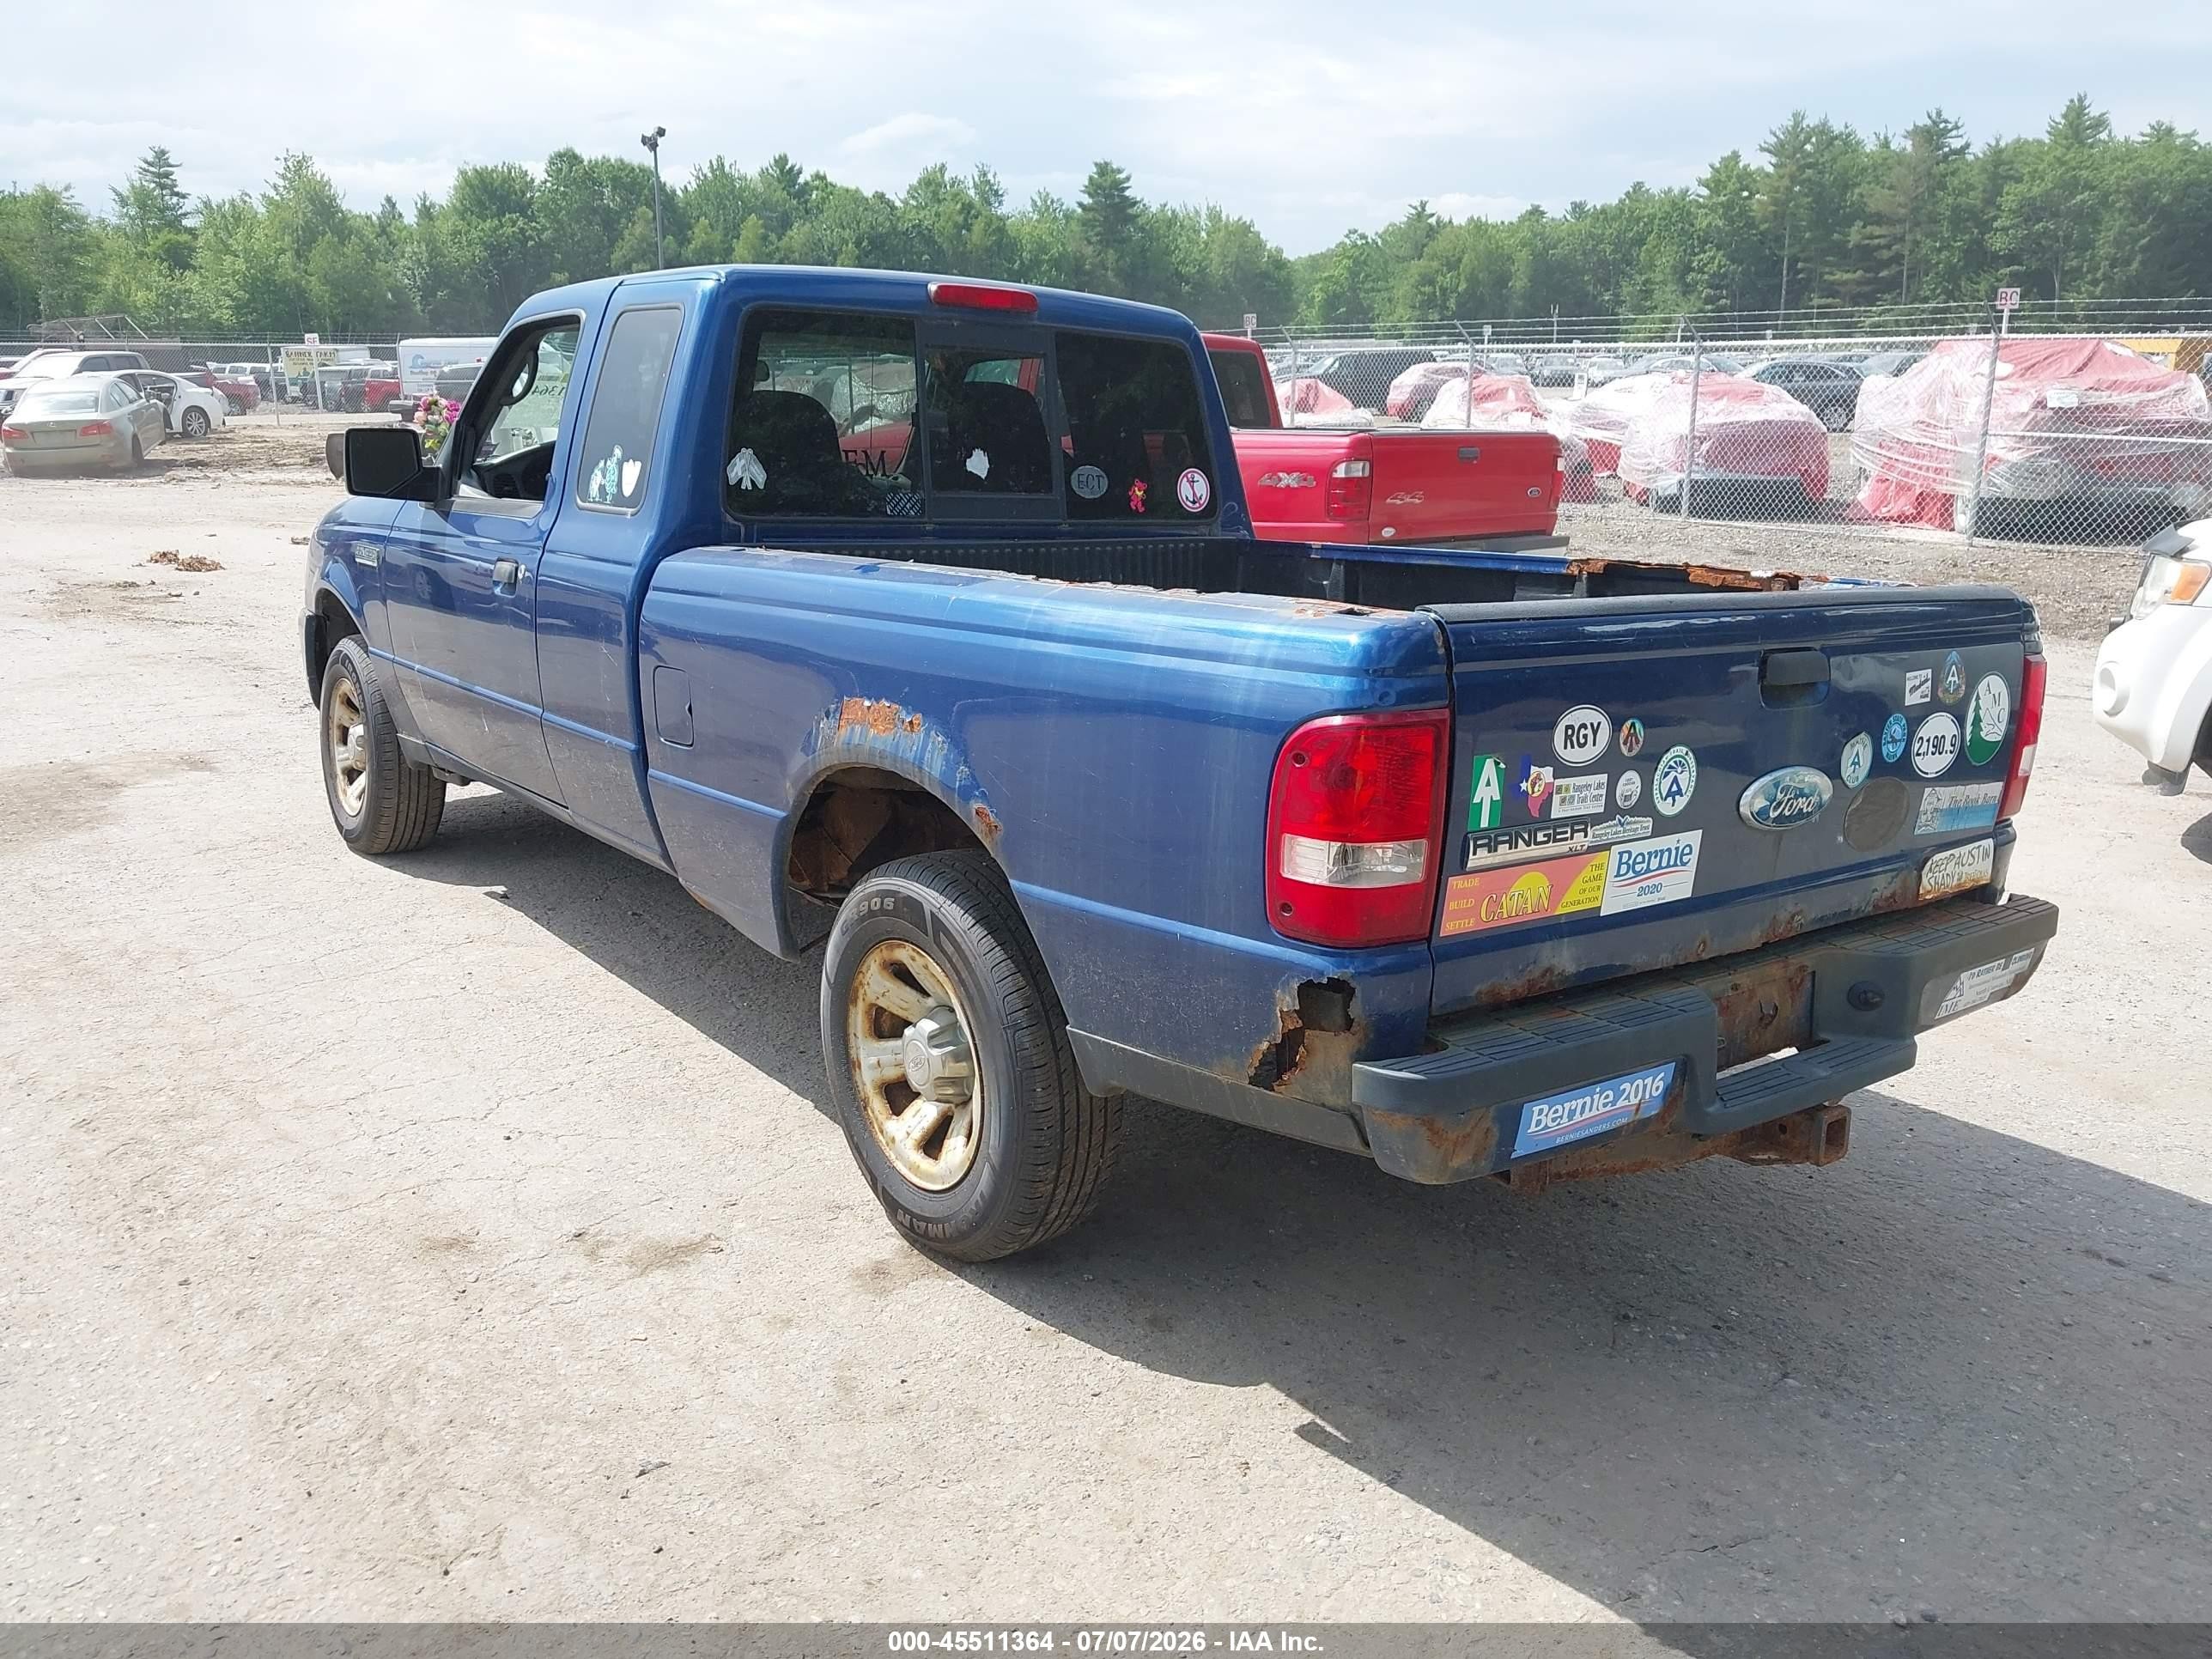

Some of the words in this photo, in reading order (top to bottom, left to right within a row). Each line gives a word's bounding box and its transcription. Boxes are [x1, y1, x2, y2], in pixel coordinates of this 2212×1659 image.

[1999, 290, 2019, 307] BC
[1078, 473, 1105, 491] ECT
[1563, 721, 1602, 750] RGY
[1915, 733, 1958, 761] 2,190.9
[1769, 782, 1820, 818] Ford
[1472, 820, 1589, 856] RANGER
[1567, 843, 1586, 853] XLT
[1589, 862, 1605, 872] THE
[1613, 839, 1693, 878] Bernie
[1926, 853, 1956, 878] KEEP
[1954, 843, 1990, 870] AUSTIN
[1452, 877, 1480, 890] TRADE
[1582, 873, 1603, 884] GAME
[1927, 871, 1956, 893] SHADY
[1588, 885, 1601, 894] OUR
[1636, 882, 1663, 897] 2020
[1449, 898, 1475, 910] BUILD
[1480, 884, 1554, 923] CATAN
[1560, 896, 1599, 908] GENERATION
[1445, 917, 1476, 931] SETTLE
[1527, 1086, 1615, 1133] Bernie
[1617, 1072, 1666, 1104] 2016
[1555, 1117, 1629, 1144] BERNIESANDERS.COM
